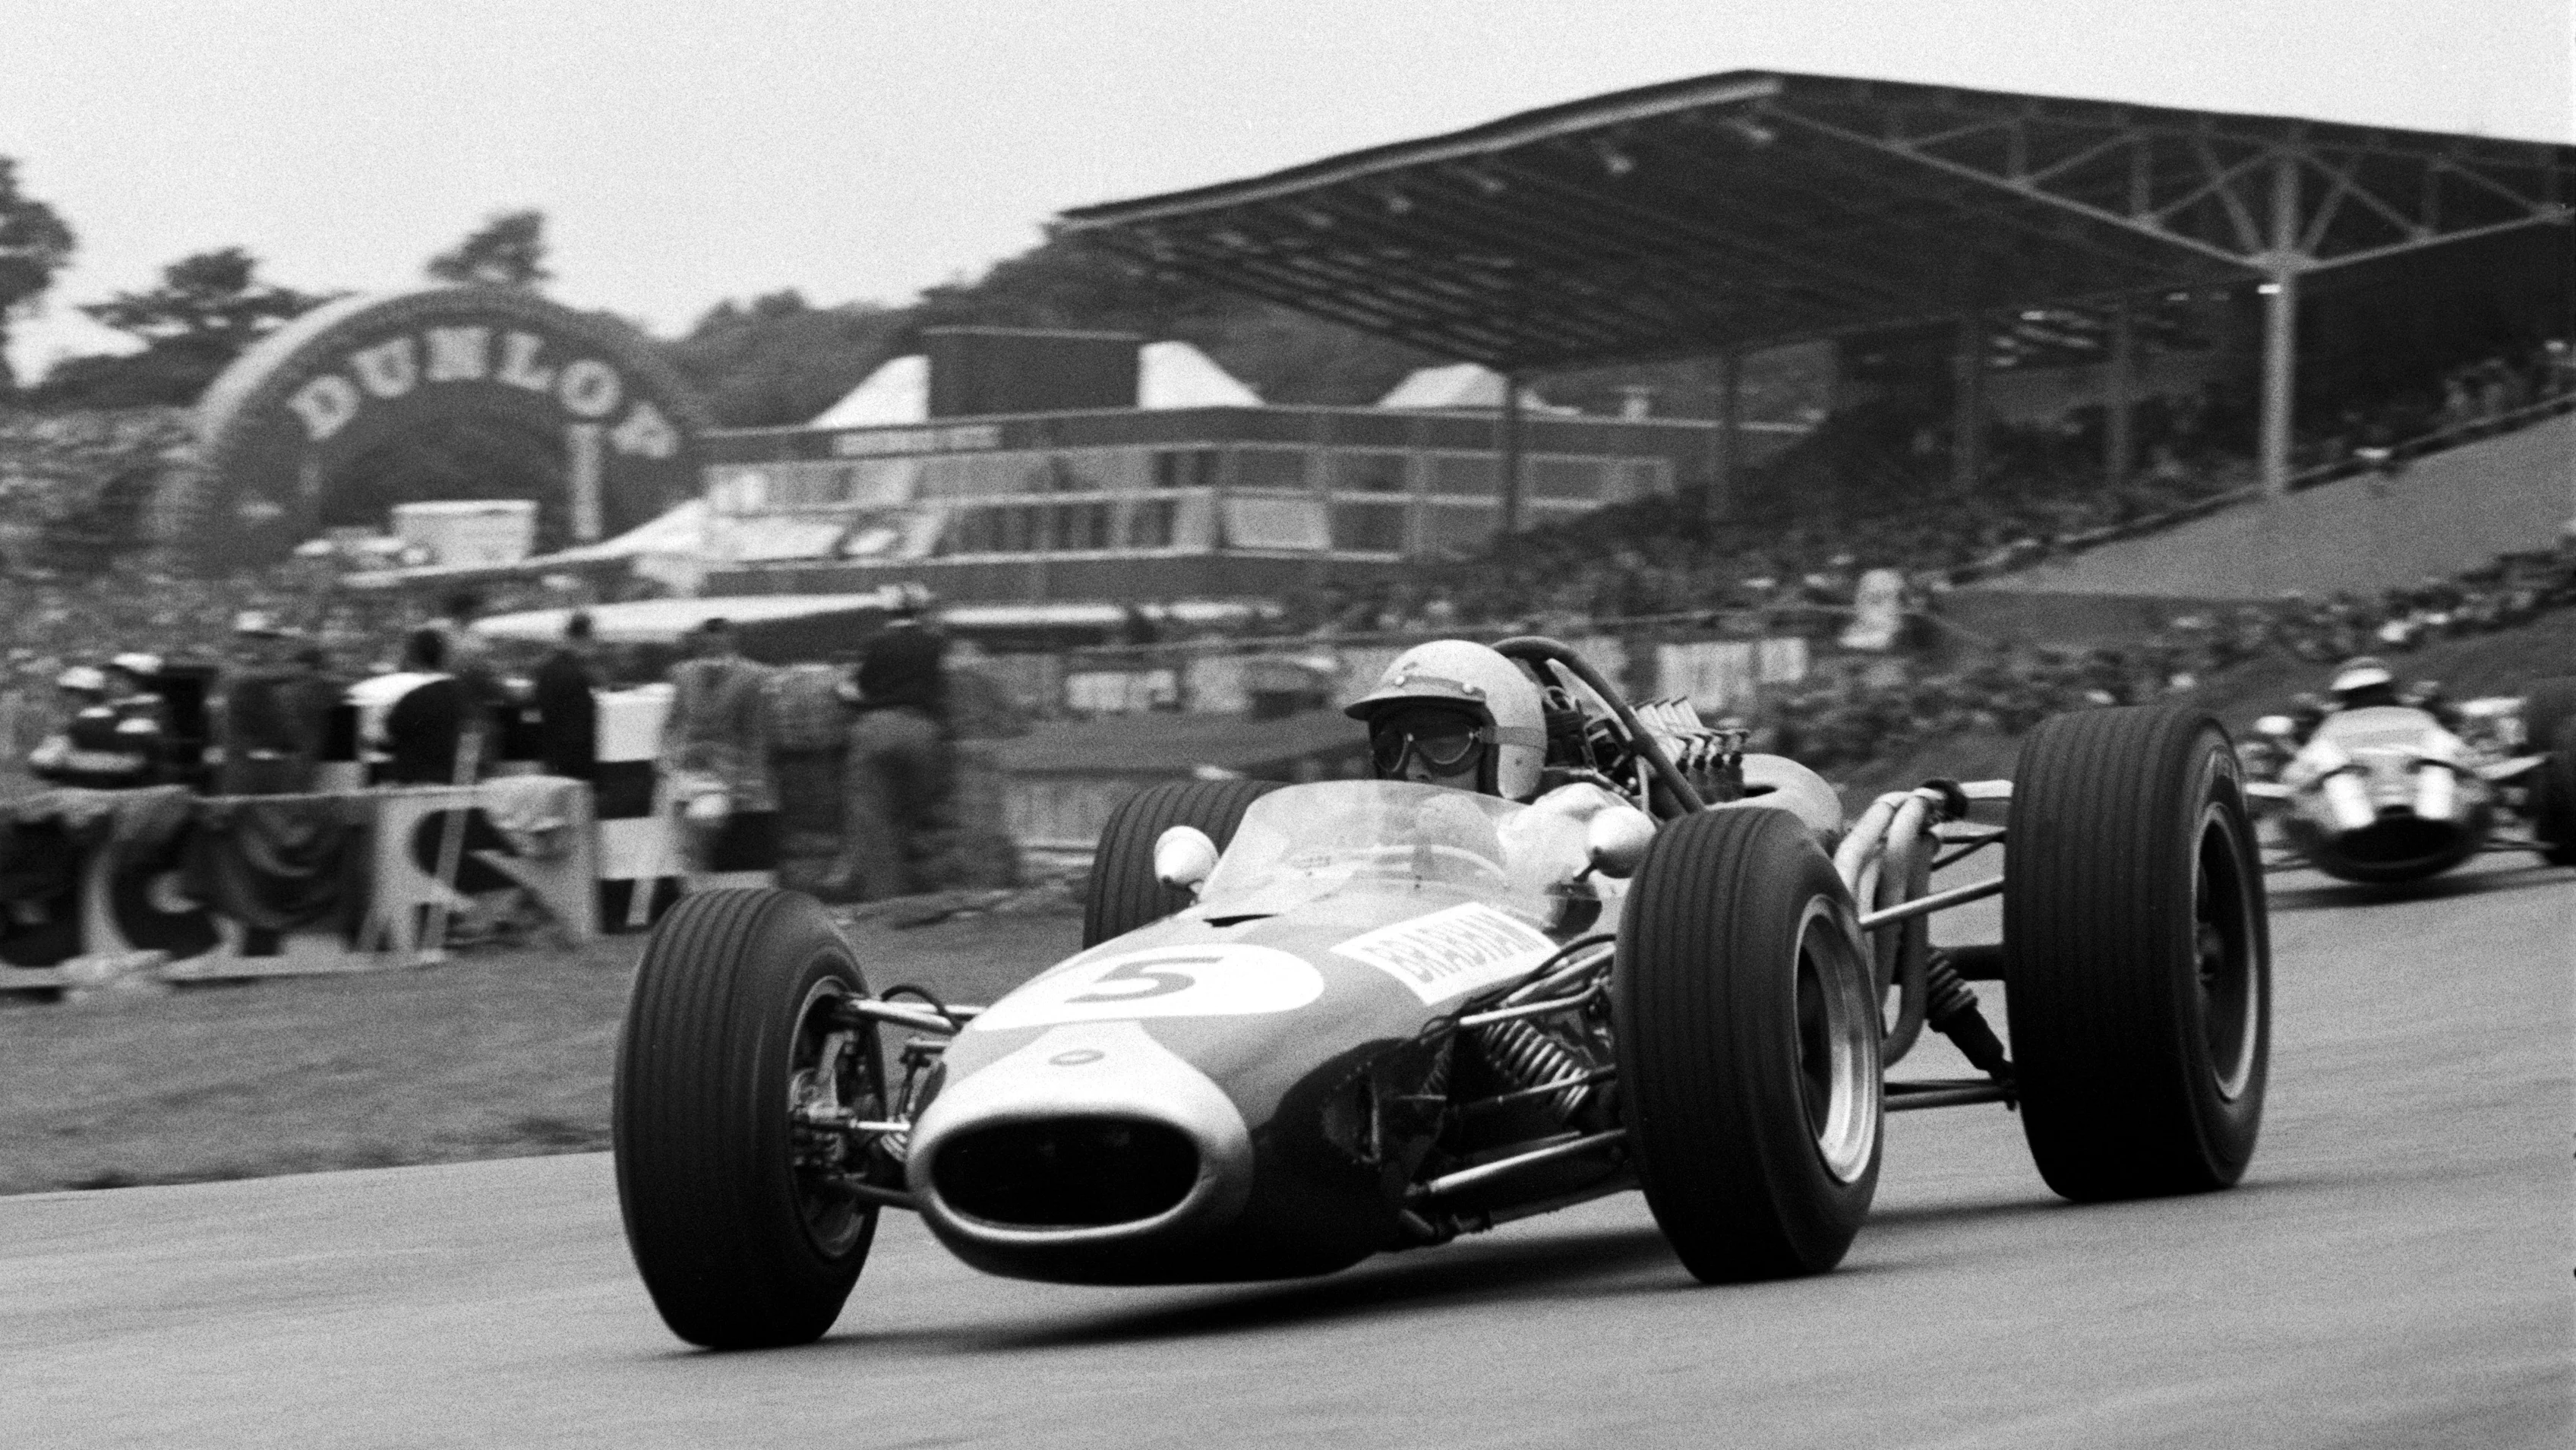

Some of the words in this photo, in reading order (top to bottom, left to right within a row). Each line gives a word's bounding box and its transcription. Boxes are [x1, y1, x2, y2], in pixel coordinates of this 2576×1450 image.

[287, 327, 679, 456] DUNLOP
[1064, 956, 1224, 1003] 5
[1361, 912, 1546, 983] BRABHAM
